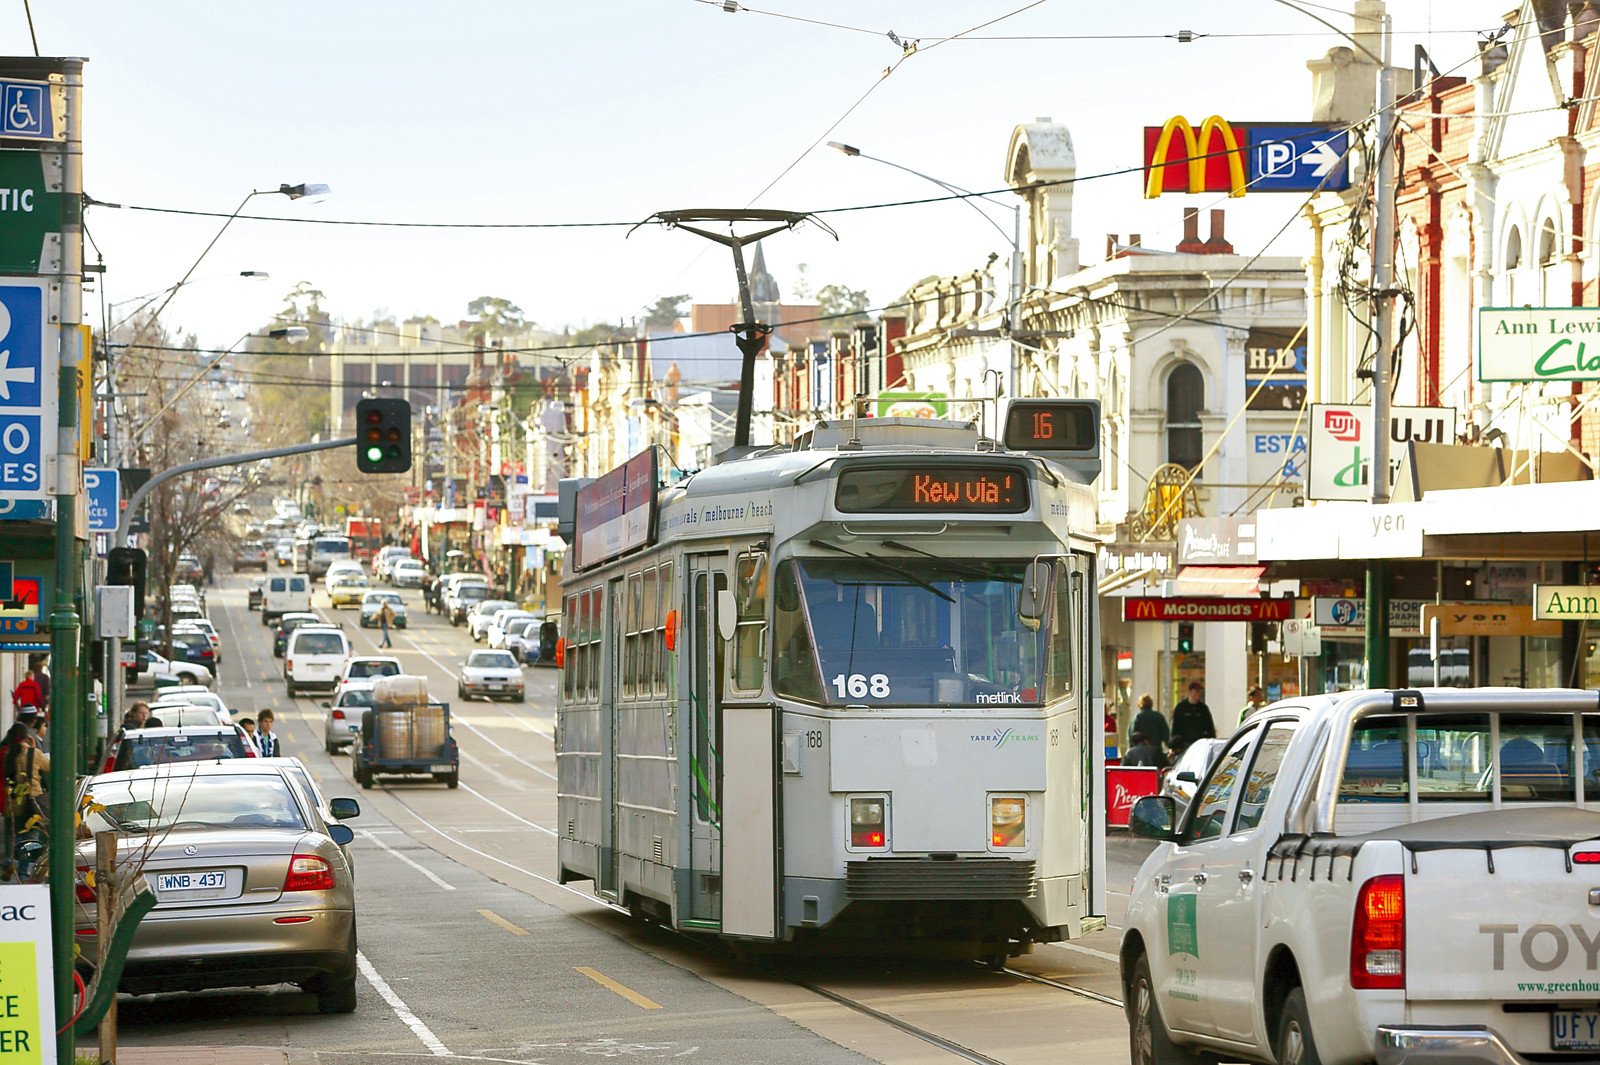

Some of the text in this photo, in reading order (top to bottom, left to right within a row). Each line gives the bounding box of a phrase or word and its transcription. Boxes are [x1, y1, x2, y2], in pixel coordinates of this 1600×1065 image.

[0, 188, 34, 212] TIC
[1494, 316, 1600, 335] Ann Lewi
[1033, 412, 1053, 439] 16
[1391, 417, 1444, 443] UJI
[0, 463, 38, 482] ES
[914, 475, 959, 503] Kew
[966, 476, 999, 503] via
[705, 505, 744, 522] melbourne
[751, 500, 773, 517] beach
[1372, 514, 1405, 537] yen
[1163, 603, 1252, 616] McDonald's
[1546, 591, 1599, 614] Ann
[1453, 614, 1506, 622] yen
[832, 673, 891, 699] 168
[976, 691, 1021, 704] metlink
[805, 730, 823, 749] 168
[0, 905, 36, 921] ac
[1517, 979, 1600, 994] www.greenhou
[1556, 1014, 1598, 1039] UFY
[0, 1030, 31, 1053] ER
